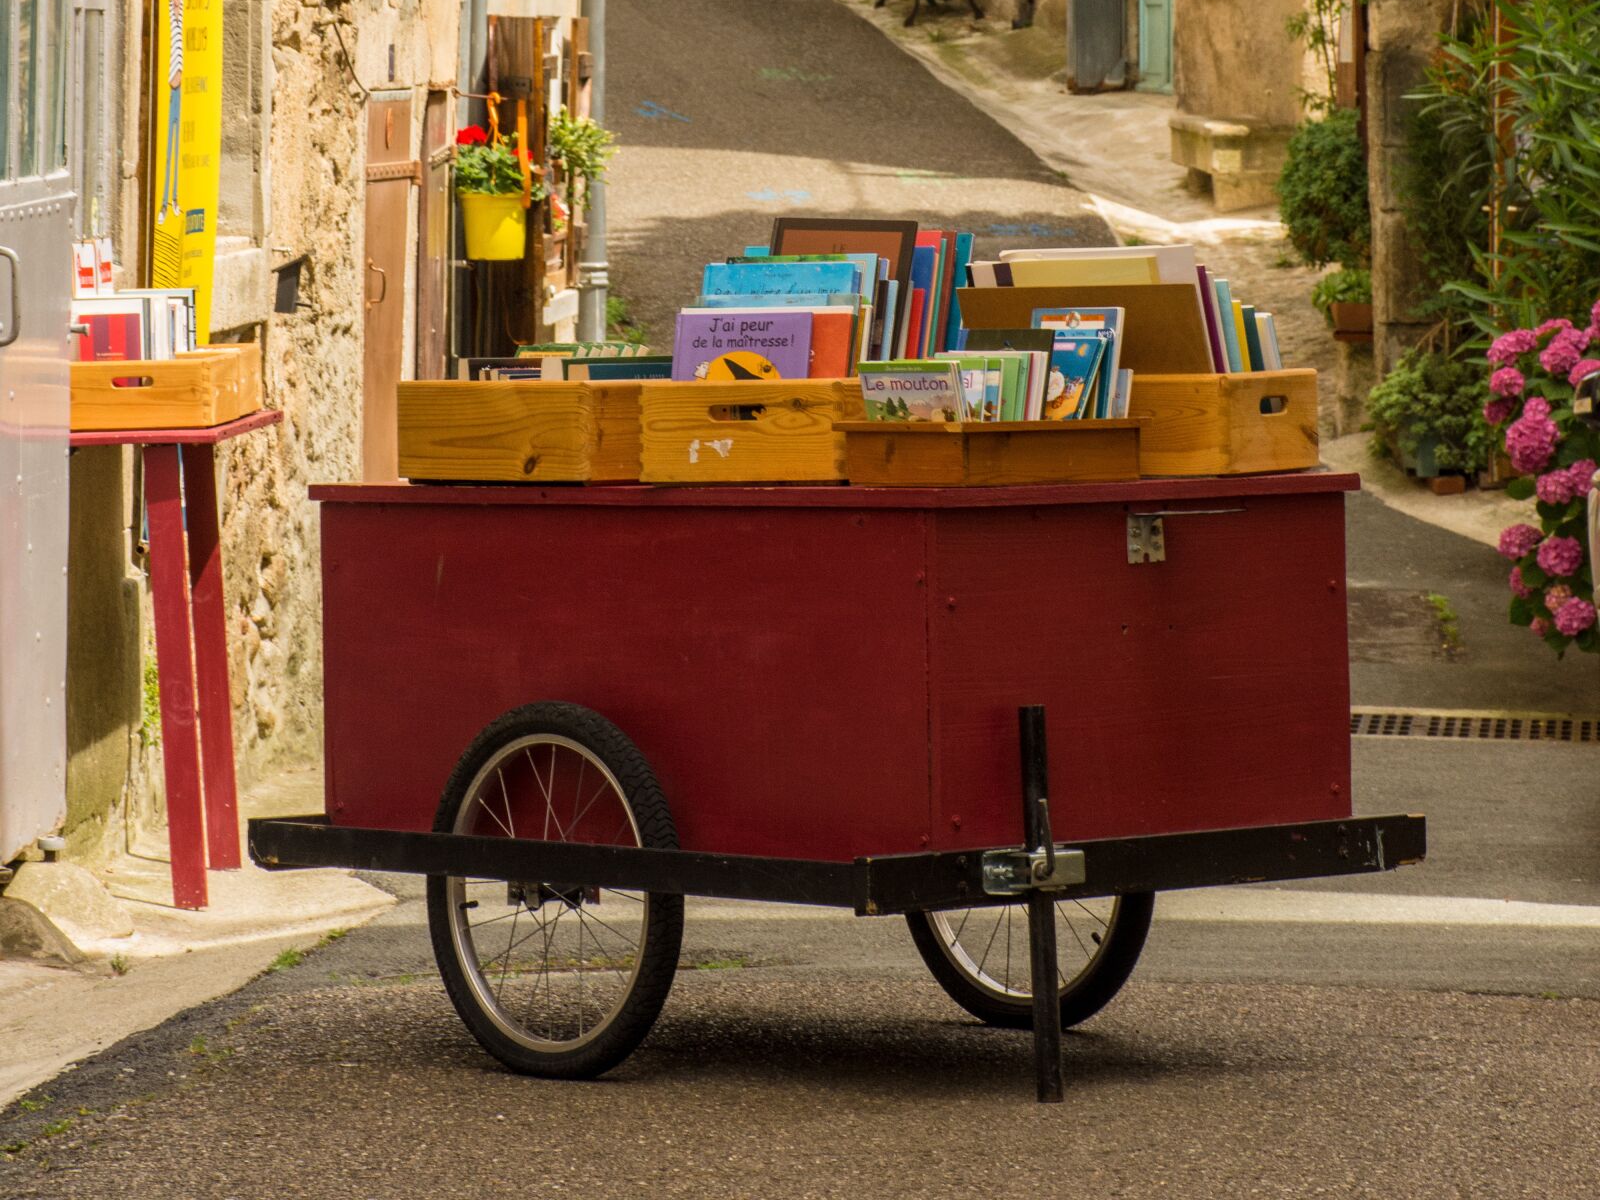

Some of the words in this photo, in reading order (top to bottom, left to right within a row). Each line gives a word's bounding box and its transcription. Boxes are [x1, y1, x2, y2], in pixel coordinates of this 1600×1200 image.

[709, 317, 735, 333] J'ai
[740, 320, 774, 336] peur
[692, 336, 707, 348] de
[712, 335, 723, 348] la
[864, 375, 885, 391] Le
[890, 376, 949, 391] mouton
